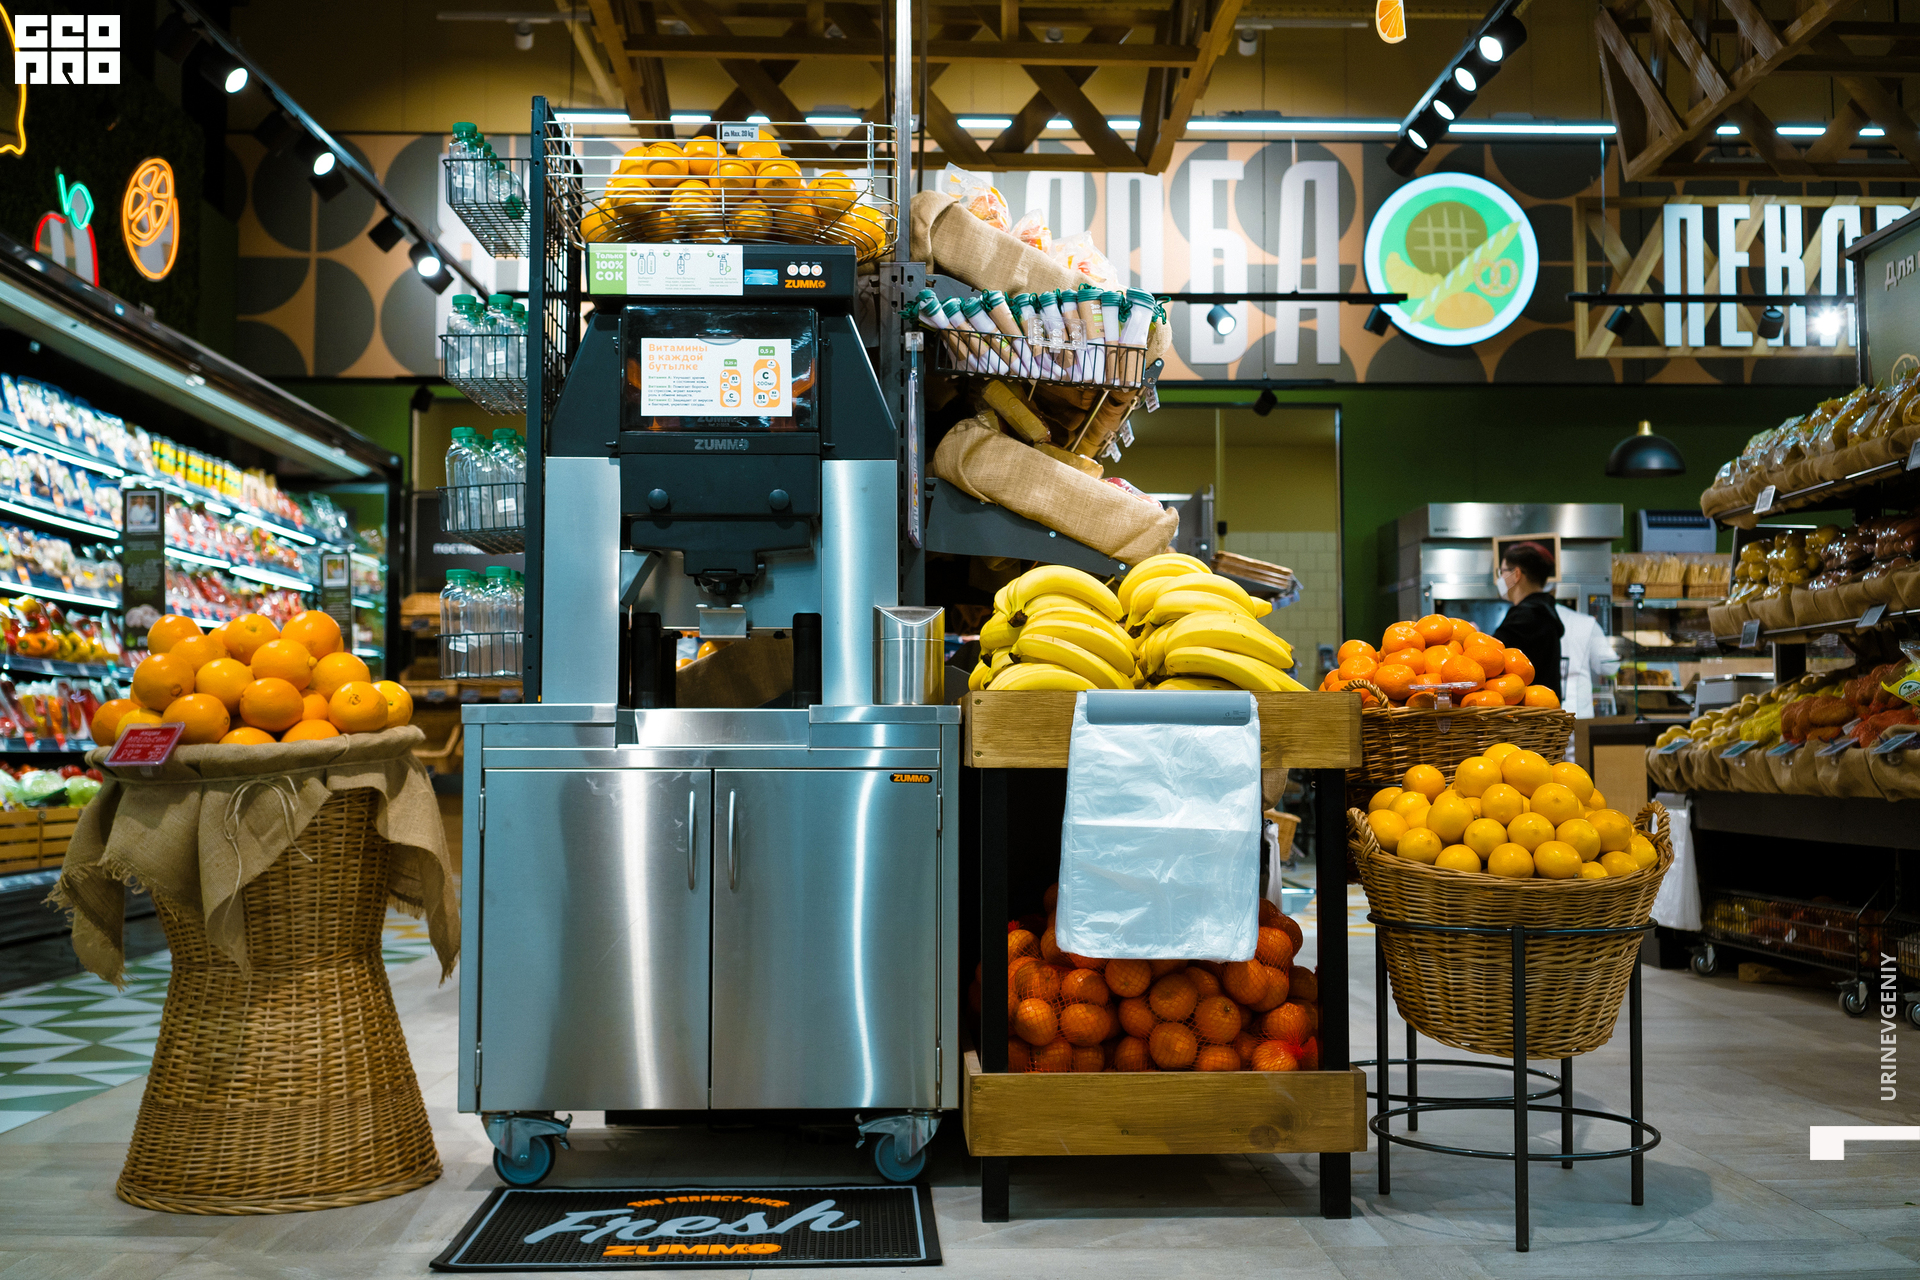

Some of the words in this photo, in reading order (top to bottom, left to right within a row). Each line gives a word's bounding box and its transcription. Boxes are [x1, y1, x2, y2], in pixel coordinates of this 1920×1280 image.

[595, 260, 624, 269] 100%
[1663, 203, 1911, 347] ПЕКА
[1884, 254, 1916, 292] Для
[784, 280, 826, 288] ZUMMO
[648, 344, 708, 352] Витамины
[658, 353, 703, 362] каждой
[648, 362, 698, 372] бутылке
[694, 438, 749, 450] ZUMMO
[893, 774, 930, 782] ZUMMO
[627, 1198, 664, 1207] THE
[664, 1195, 742, 1203] PERFECT
[742, 1197, 790, 1208] JUICE
[523, 1199, 860, 1244] Fresh
[602, 1244, 782, 1257] ZUMMO
